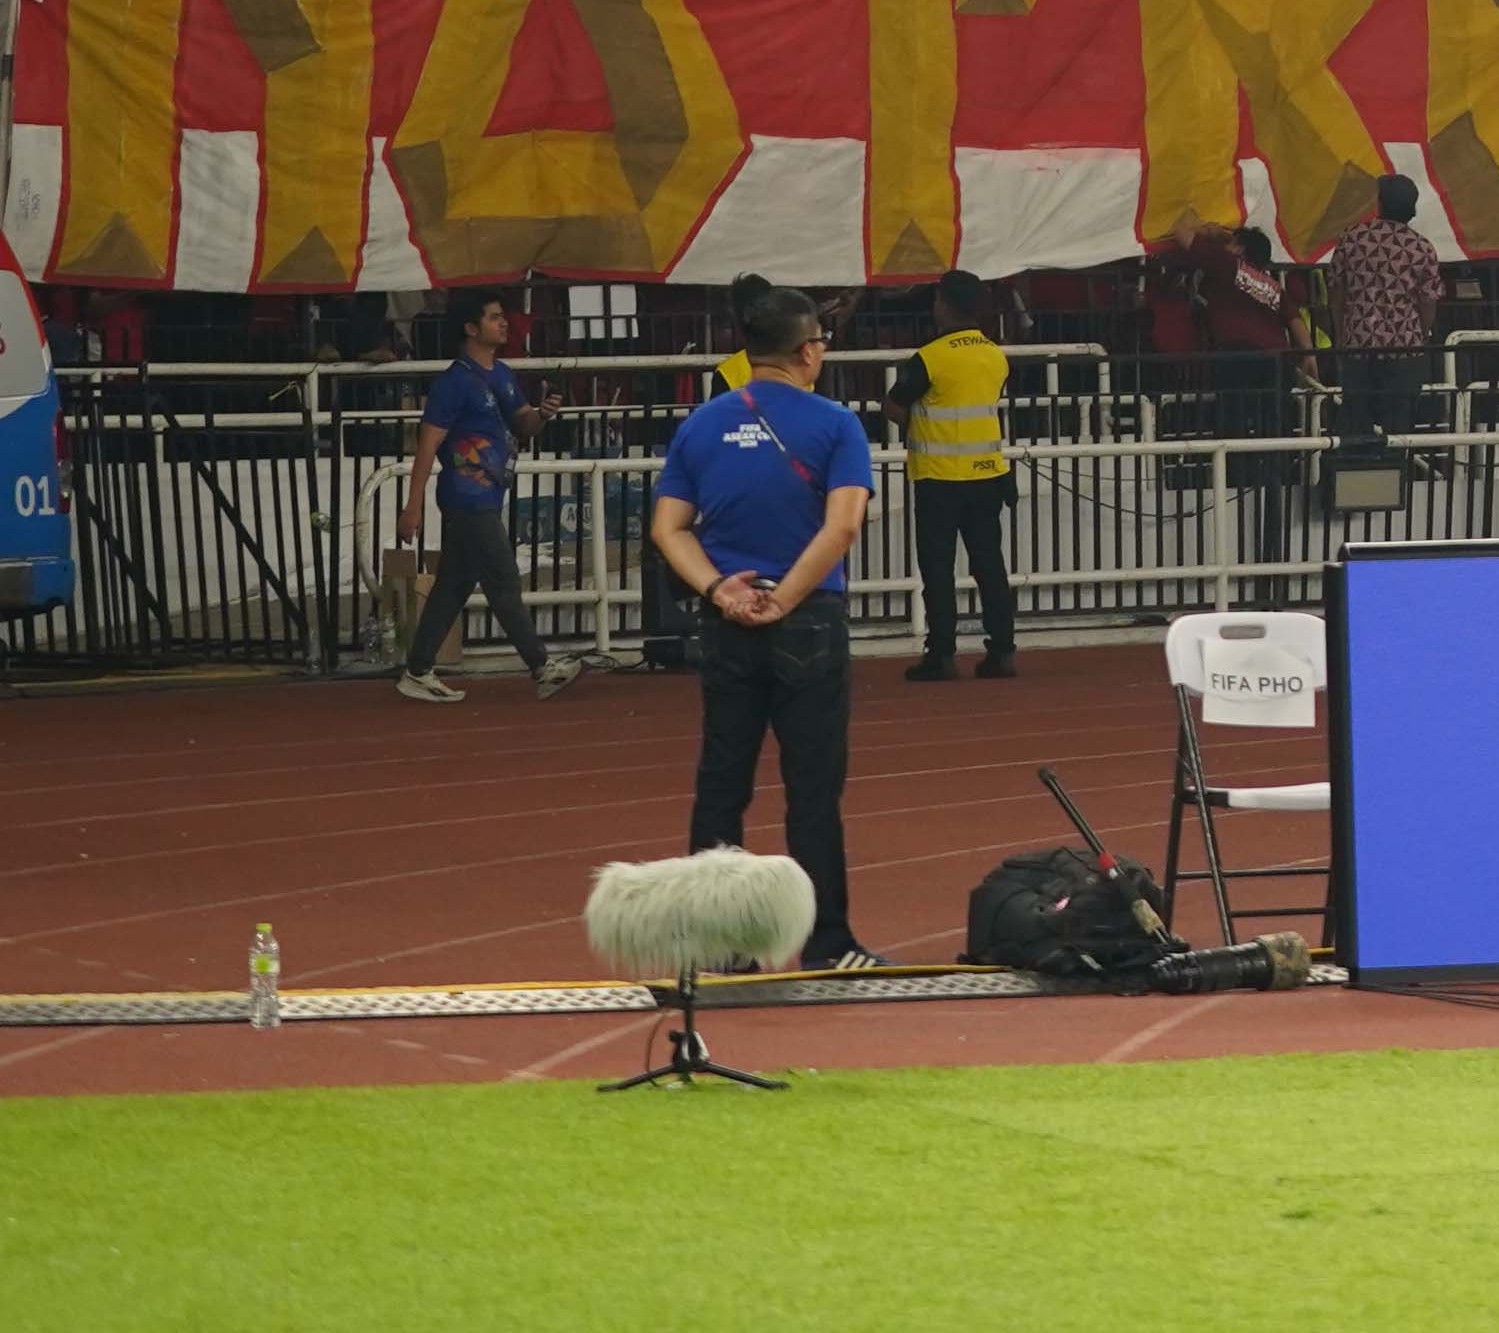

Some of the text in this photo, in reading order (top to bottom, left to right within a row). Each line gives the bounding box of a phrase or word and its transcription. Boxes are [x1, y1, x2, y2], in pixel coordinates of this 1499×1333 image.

[14, 475, 56, 517] 01
[1210, 673, 1304, 694] FIFA PHO
